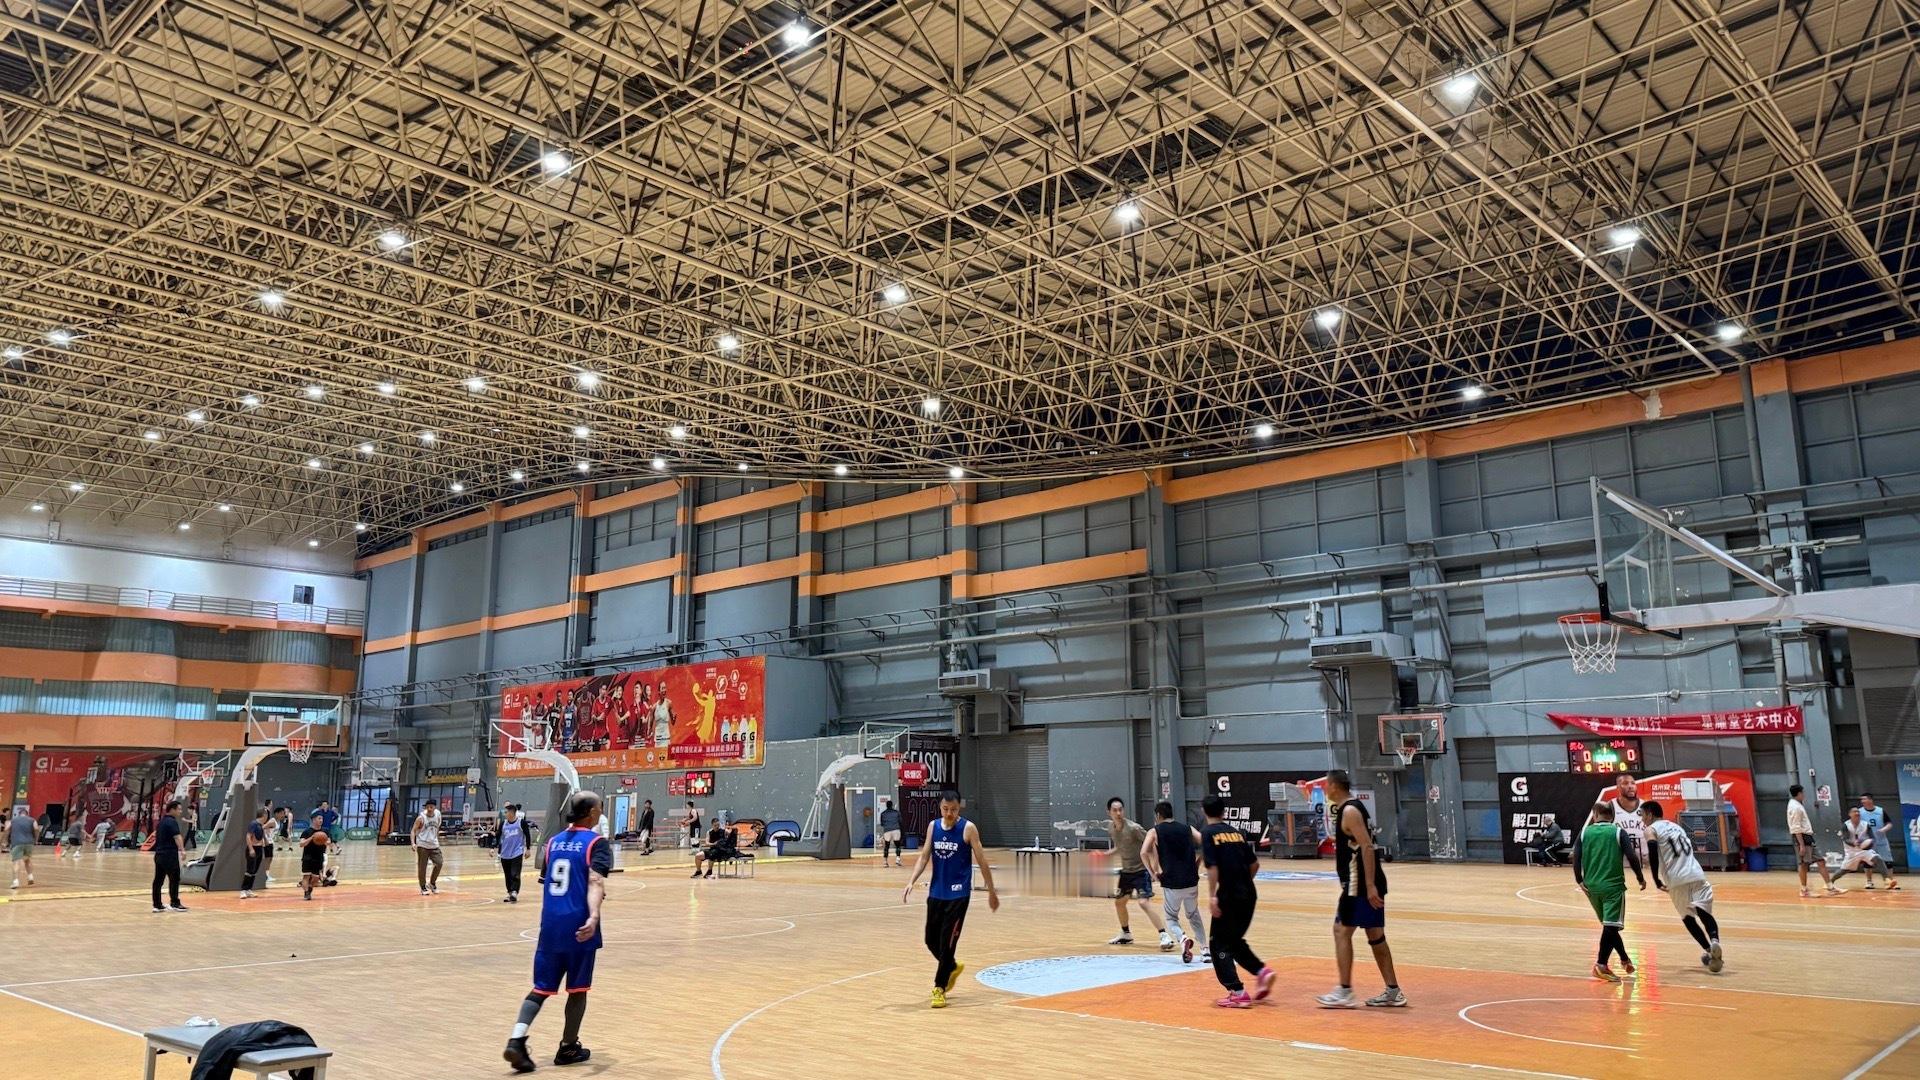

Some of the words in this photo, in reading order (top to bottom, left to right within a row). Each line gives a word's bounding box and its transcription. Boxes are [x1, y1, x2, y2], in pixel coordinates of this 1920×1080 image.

[1583, 750, 1591, 762] 0
[1627, 749, 1635, 761] 0
[36, 757, 48, 769] G
[1599, 762, 1613, 772] 24
[1217, 776, 1231, 792] G
[1511, 777, 1528, 795] G
[92, 802, 111, 813] 23
[1315, 803, 1323, 814] G
[1667, 835, 1692, 858] 10
[549, 859, 571, 896] 9
